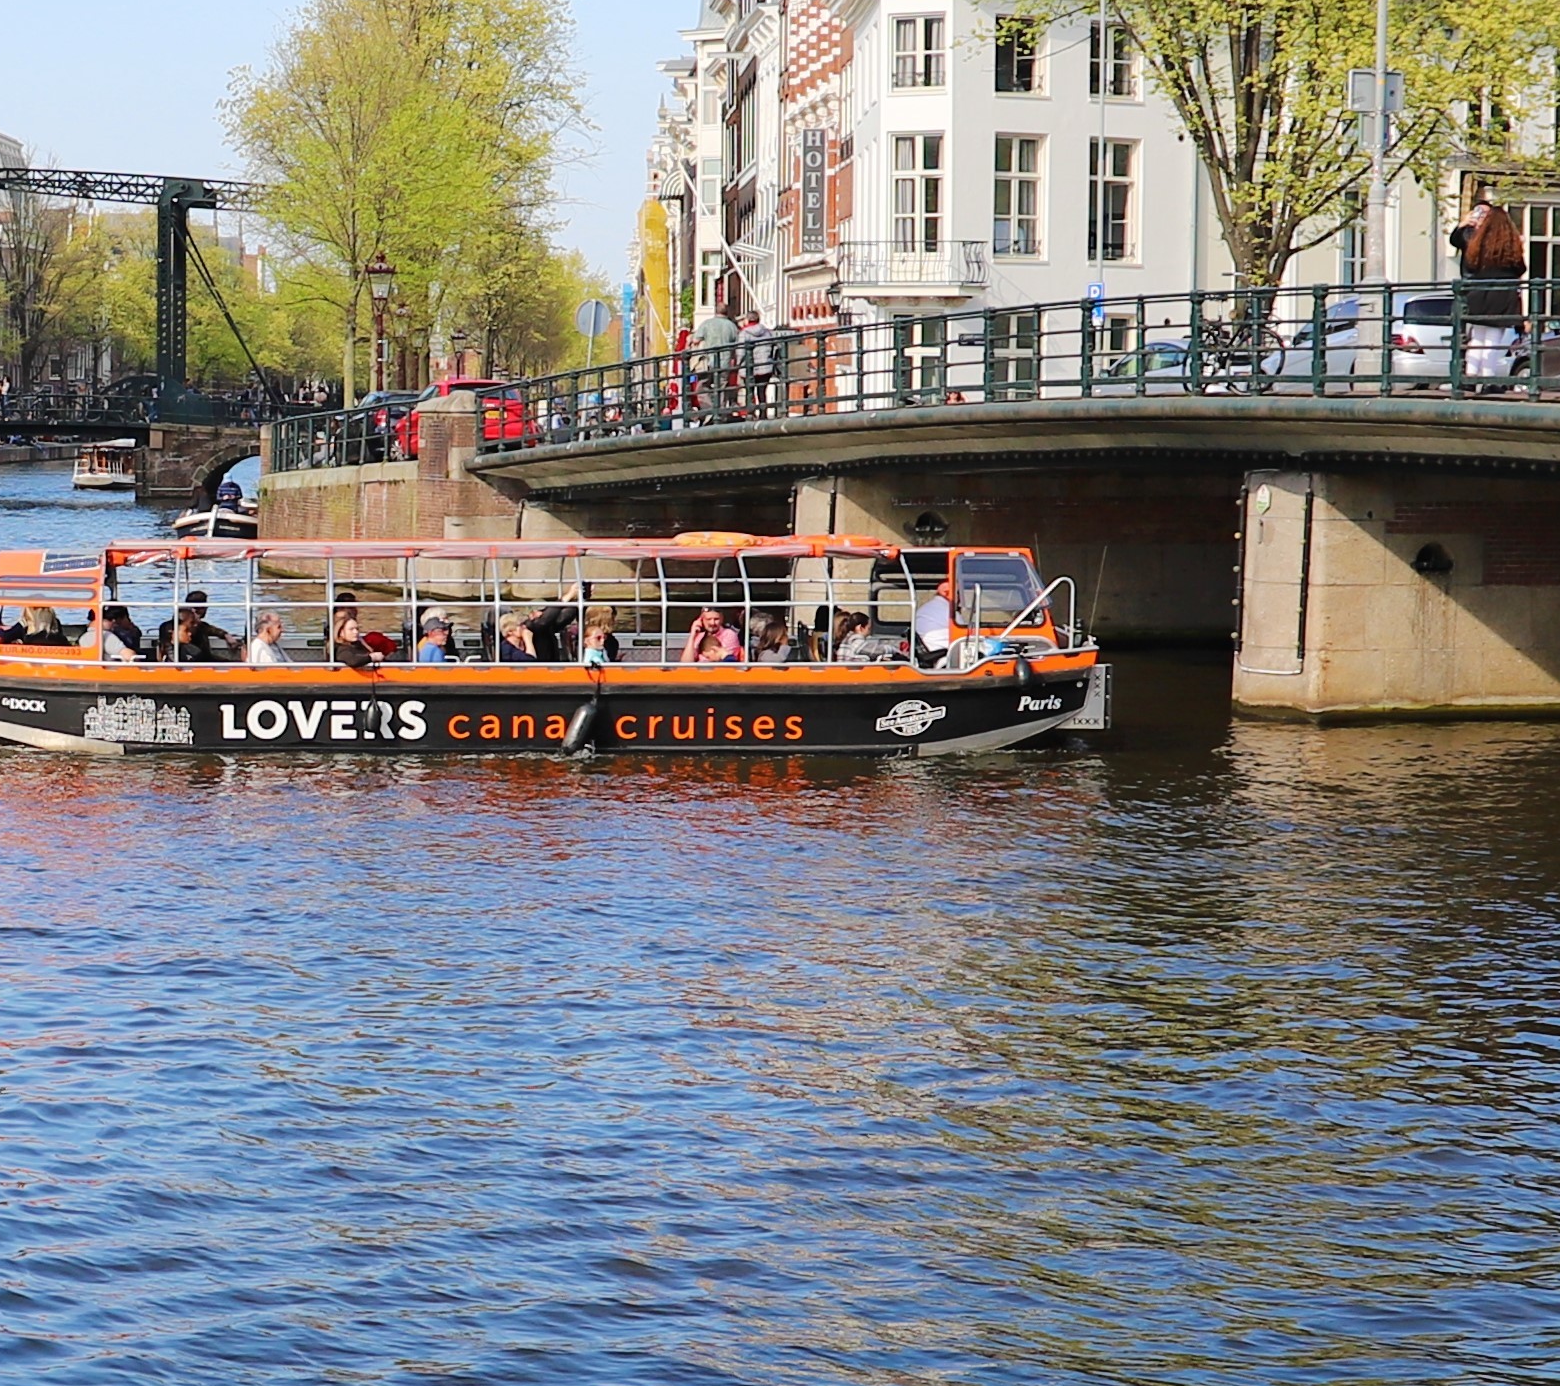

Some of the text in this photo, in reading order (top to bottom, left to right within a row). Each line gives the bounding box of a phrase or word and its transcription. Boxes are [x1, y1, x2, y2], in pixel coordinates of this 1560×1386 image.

[805, 130, 822, 229] HOTEL
[803, 242, 823, 251] NES
[218, 699, 427, 741] LOVERS
[1017, 695, 1062, 712] Paris
[447, 708, 804, 741] cana cruises
